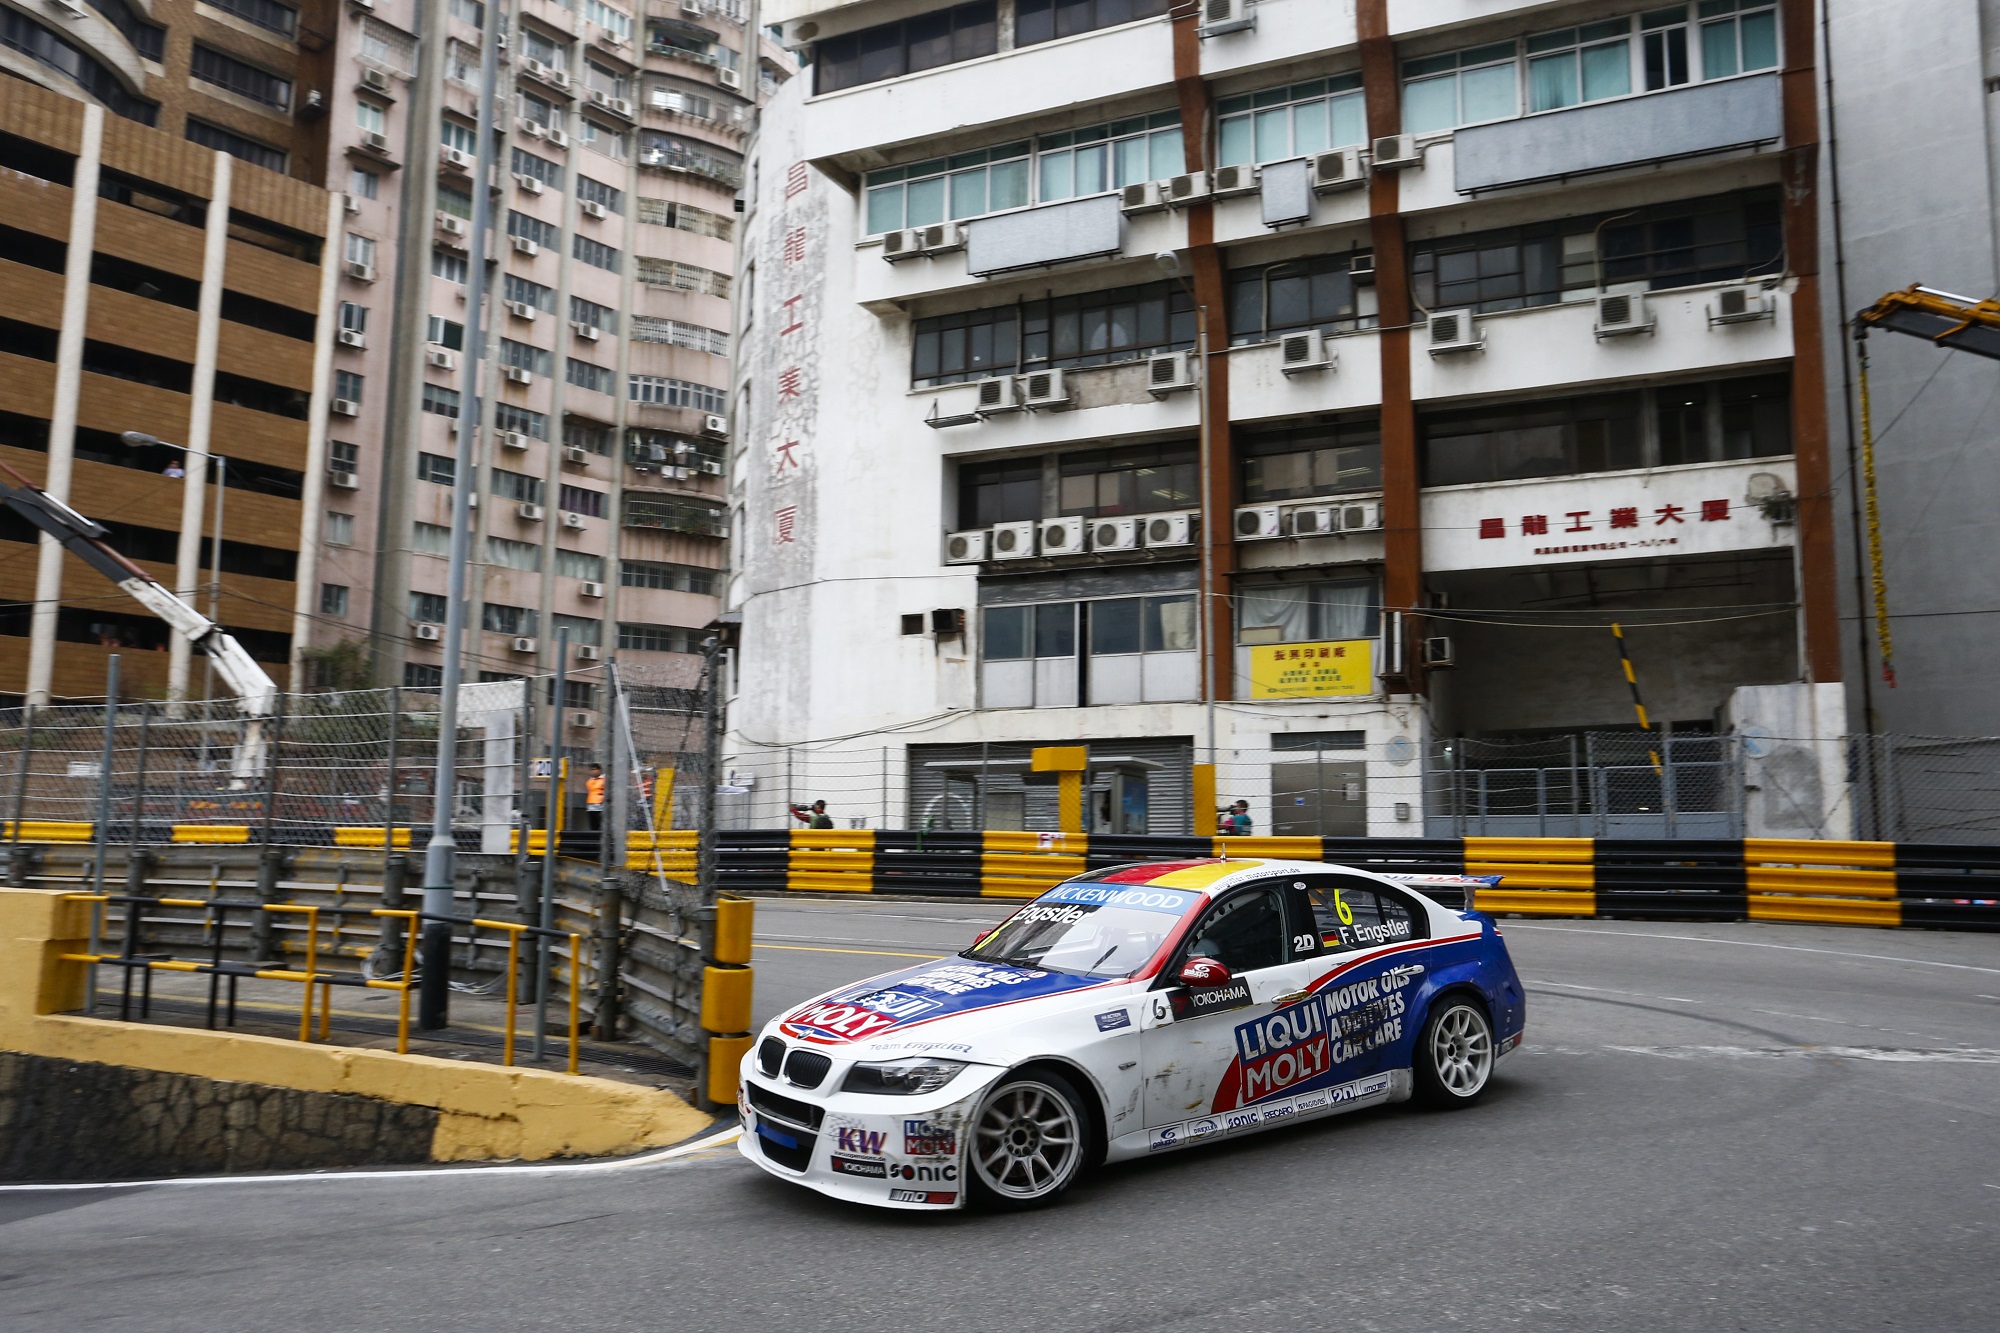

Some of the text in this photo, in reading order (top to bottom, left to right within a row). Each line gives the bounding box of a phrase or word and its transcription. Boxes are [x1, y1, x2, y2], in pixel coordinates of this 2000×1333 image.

[1009, 904, 1096, 926] Engstler
[1333, 888, 1353, 926] 6
[1293, 934, 1315, 952] 2D
[1338, 919, 1411, 945] F. Engstler
[1152, 998, 1167, 1020] 6
[1189, 985, 1248, 1007] YOKOHAMA
[1325, 977, 1379, 1017] MOTOR
[790, 1003, 894, 1037] MOLY
[1240, 1001, 1322, 1060] LIQUI
[1332, 1038, 1364, 1064] CAR
[1246, 1037, 1326, 1098] MOLY
[1264, 1106, 1293, 1119] RECARO
[839, 1127, 888, 1155] KW
[842, 1162, 885, 1175] YOKOHAMA
